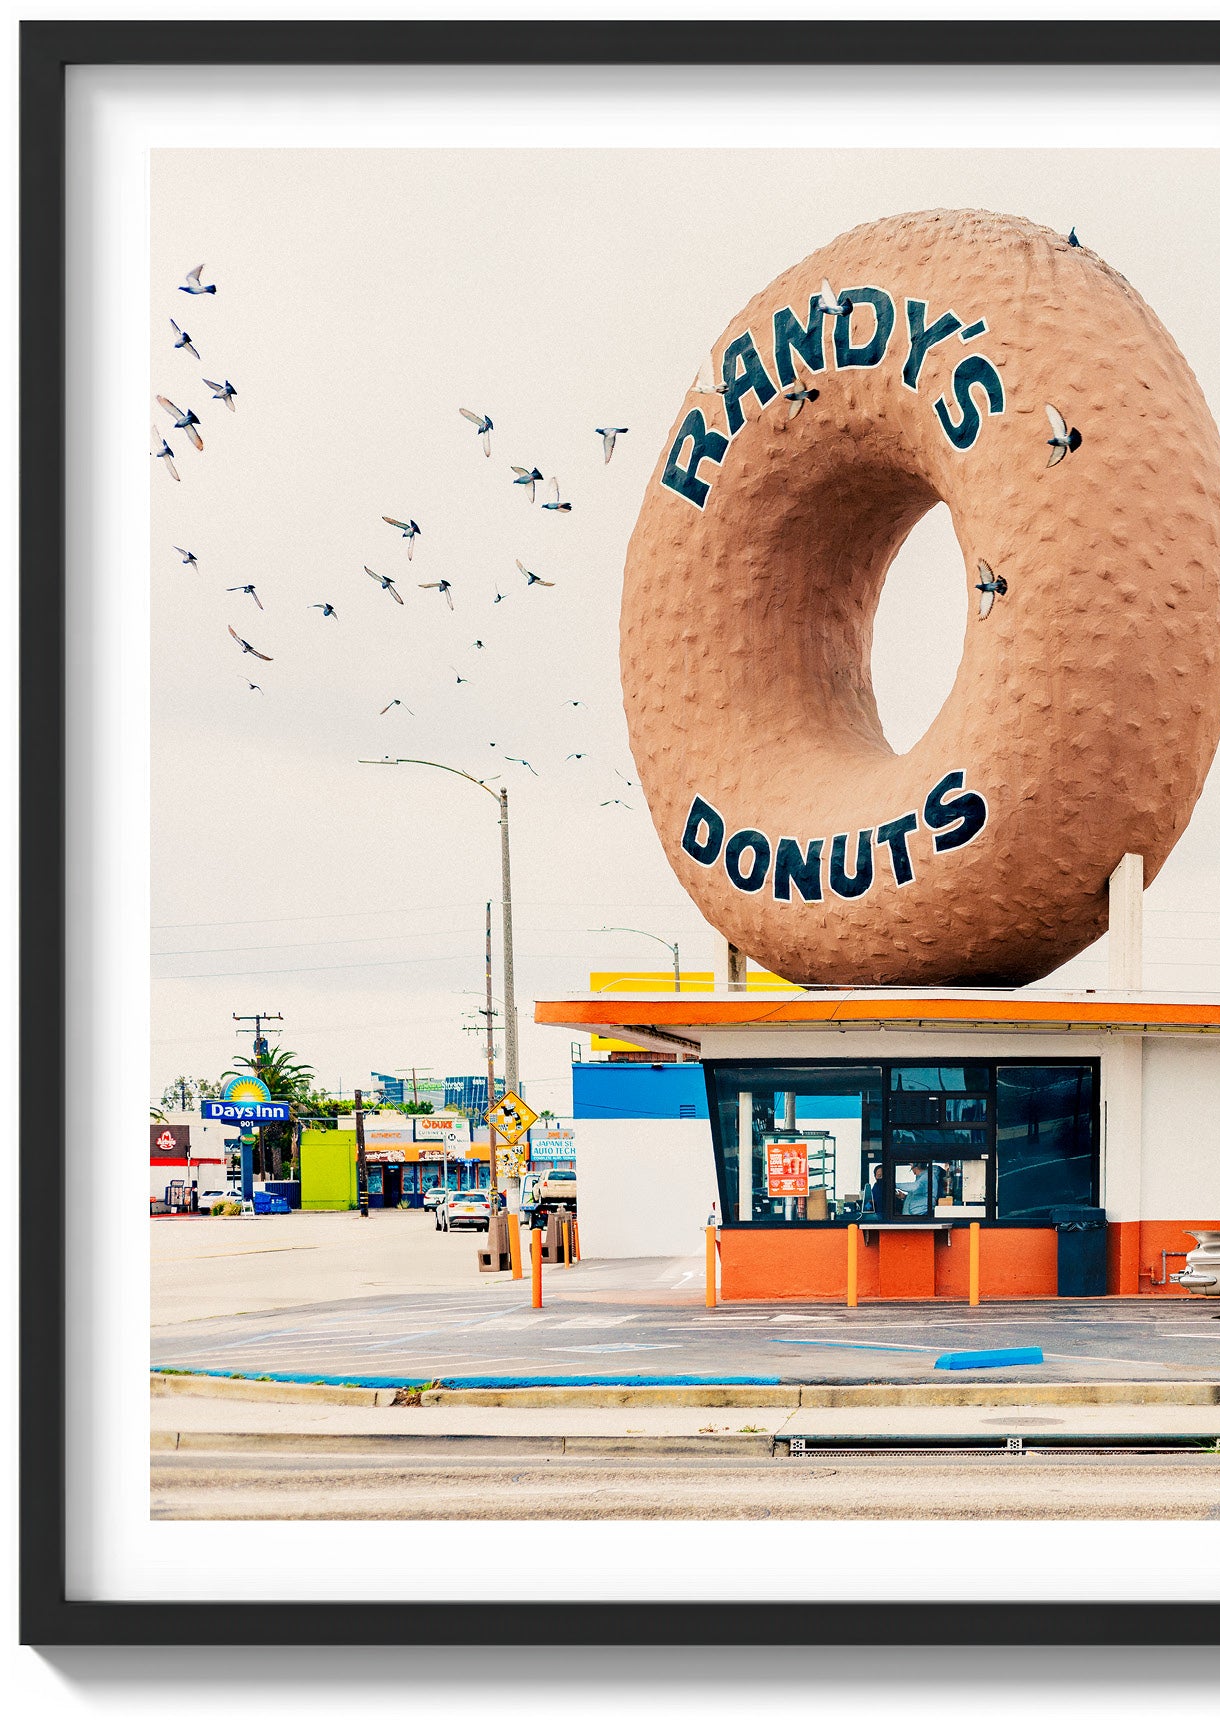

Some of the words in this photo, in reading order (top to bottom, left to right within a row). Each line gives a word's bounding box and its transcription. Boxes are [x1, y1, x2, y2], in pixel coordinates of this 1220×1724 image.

[661, 285, 1006, 510] RANDY'S
[682, 768, 989, 903] DONUTS
[441, 1080, 464, 1091] Storage
[211, 1103, 254, 1119] Days
[256, 1104, 285, 1118] Inn
[240, 1120, 254, 1128] 901
[431, 1120, 453, 1129] DUKE
[534, 1147, 554, 1155] AUTO
[555, 1147, 576, 1155] TECH
